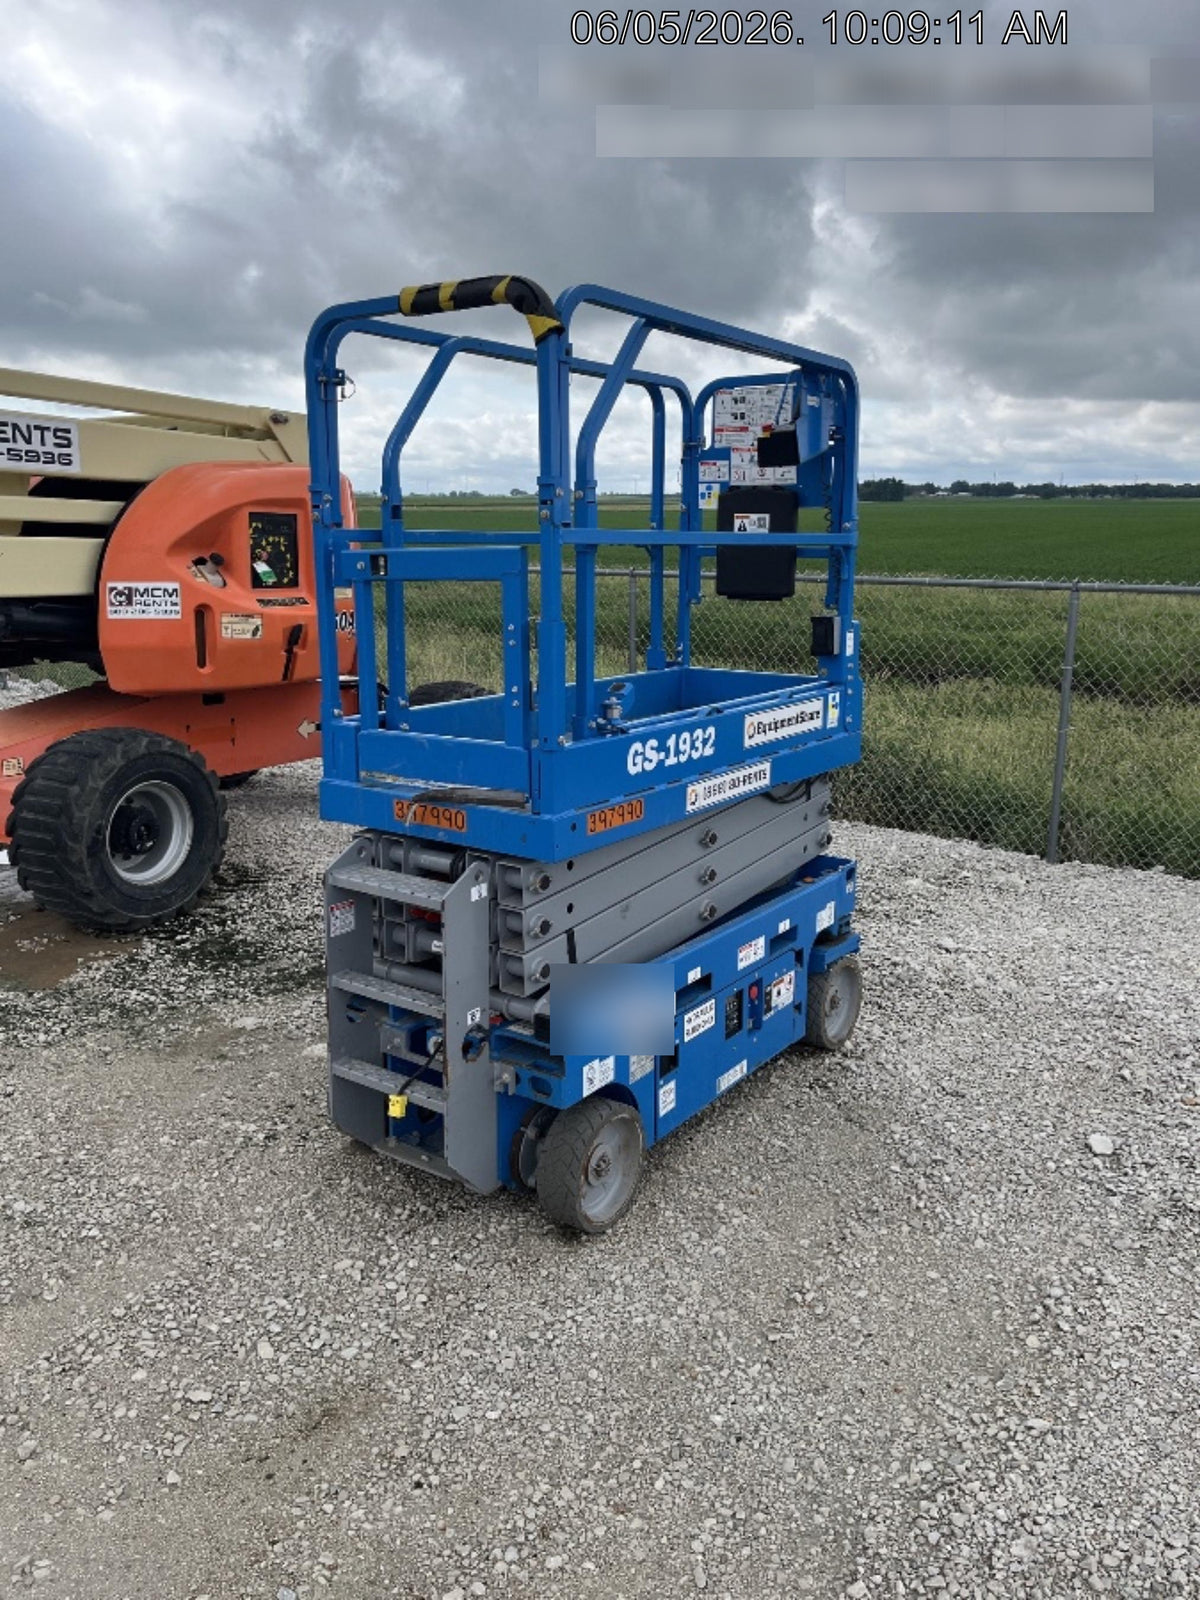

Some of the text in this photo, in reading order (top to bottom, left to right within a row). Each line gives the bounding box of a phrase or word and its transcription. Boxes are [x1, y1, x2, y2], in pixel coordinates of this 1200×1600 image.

[134, 587, 179, 598] MCM
[627, 726, 716, 776] GS-1932
[590, 800, 643, 833] 397990
